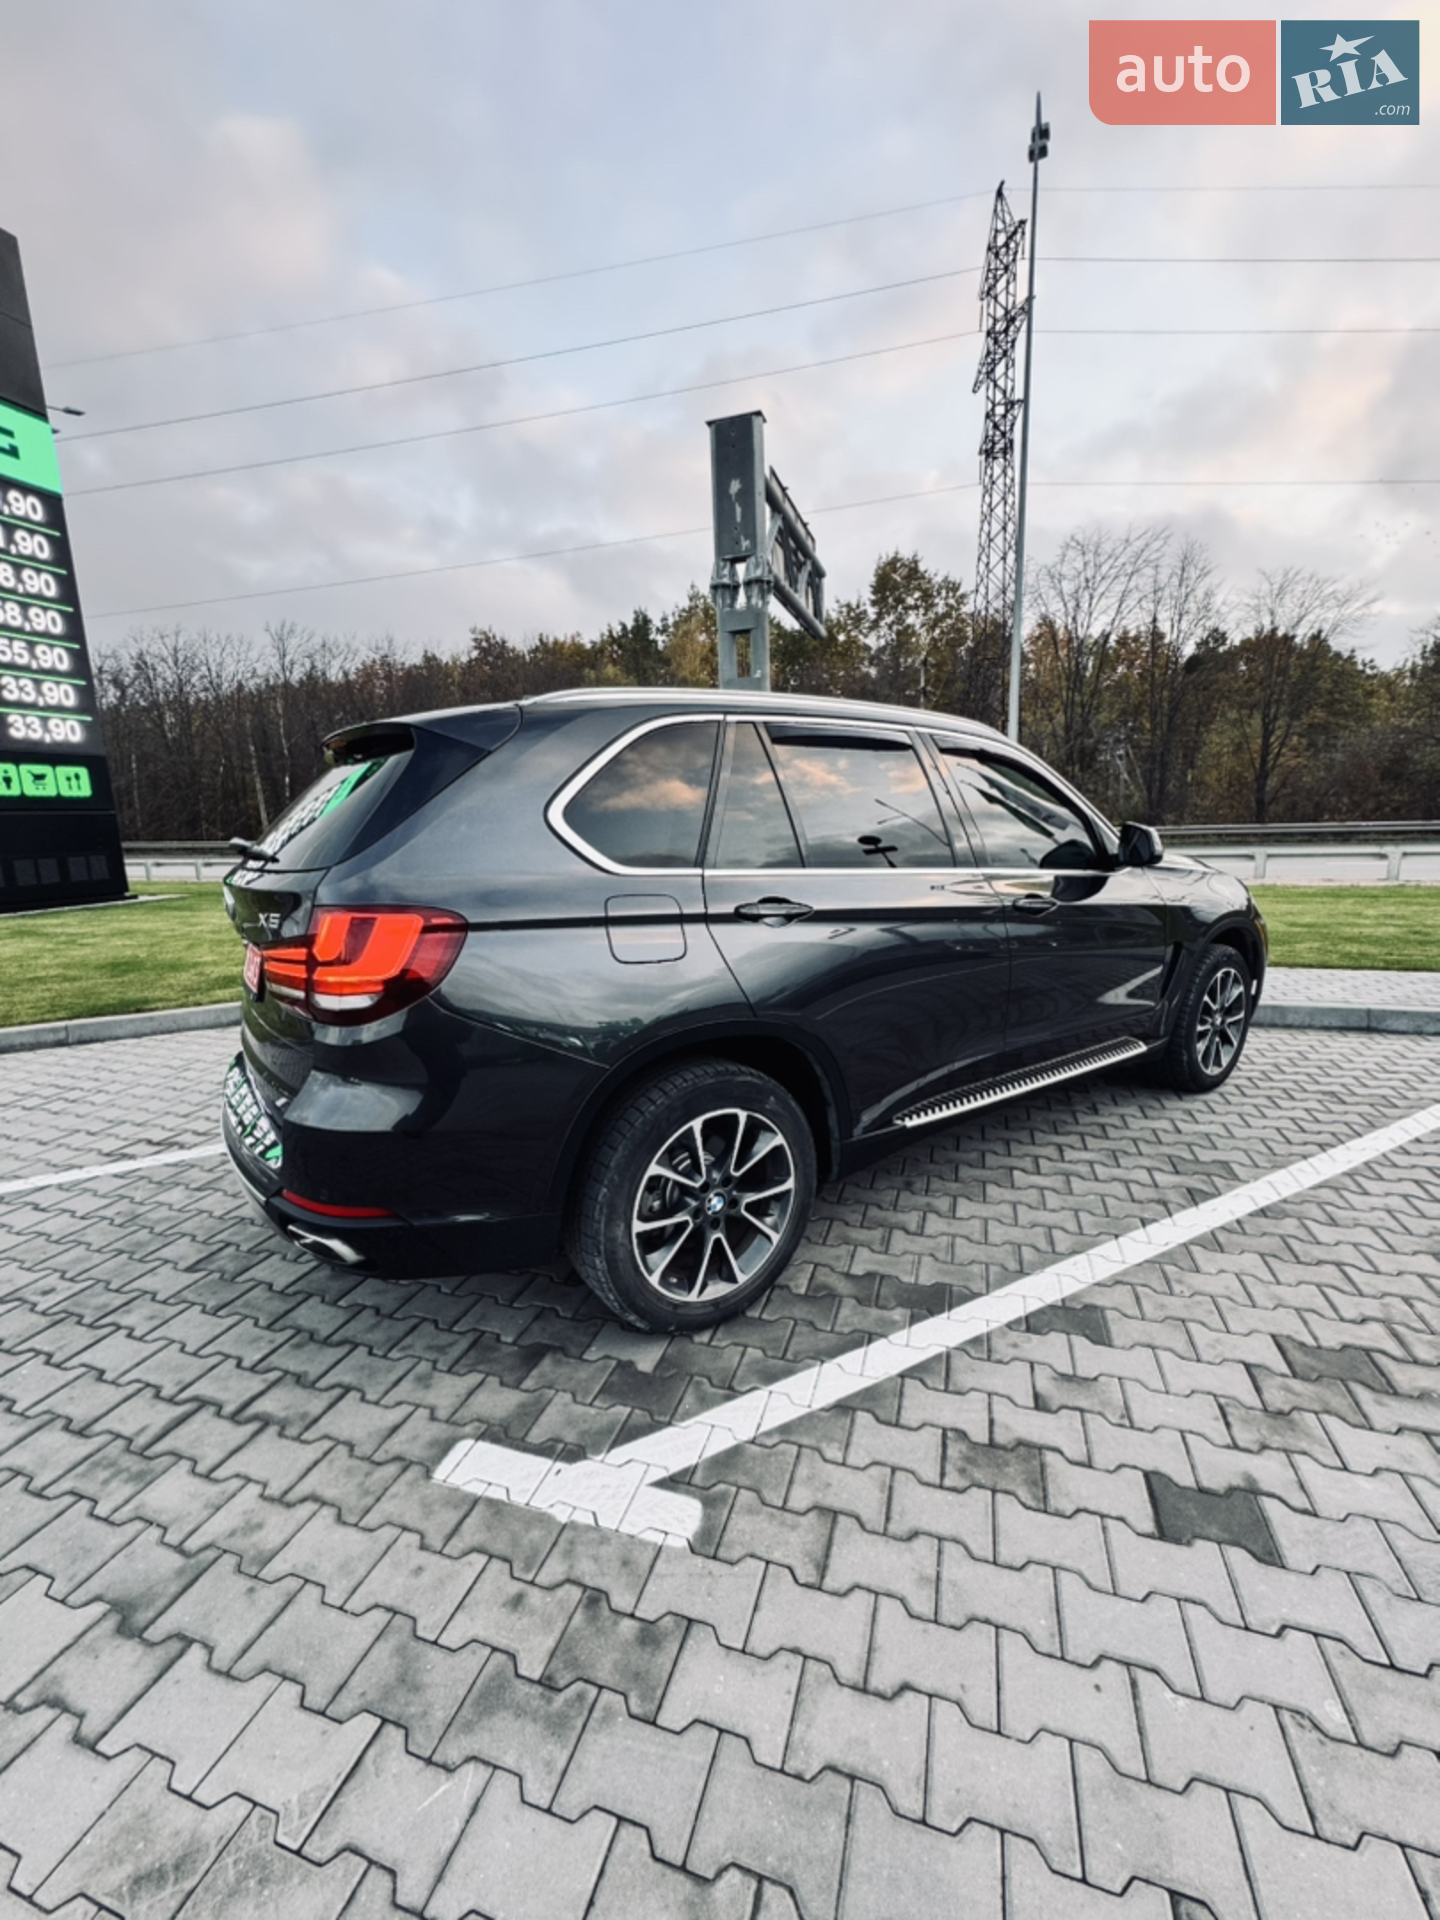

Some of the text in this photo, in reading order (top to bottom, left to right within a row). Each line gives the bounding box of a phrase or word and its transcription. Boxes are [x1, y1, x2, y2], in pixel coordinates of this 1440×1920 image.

[0, 600, 62, 635] 8,90
[1, 675, 76, 707] 33,90
[7, 714, 82, 743] 33,90
[258, 912, 281, 928] X5
